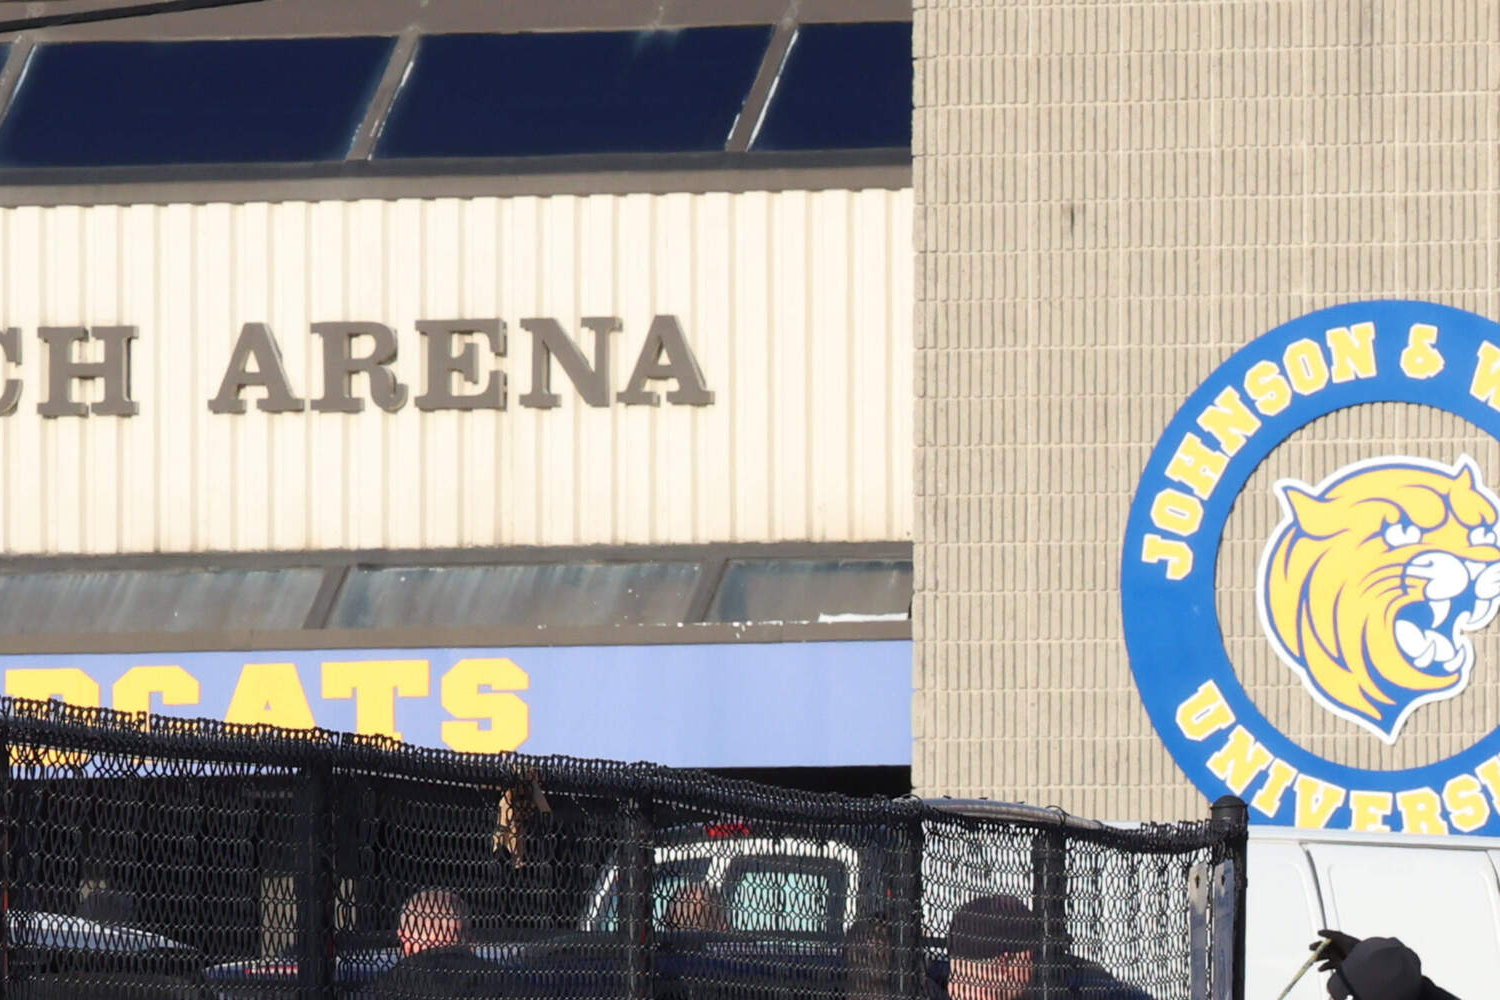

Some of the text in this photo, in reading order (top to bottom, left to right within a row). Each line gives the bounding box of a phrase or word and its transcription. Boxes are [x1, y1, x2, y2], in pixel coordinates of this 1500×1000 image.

[207, 314, 716, 413] ARENA
[1141, 321, 1378, 581] JOHNSON
[1400, 323, 1445, 379] &
